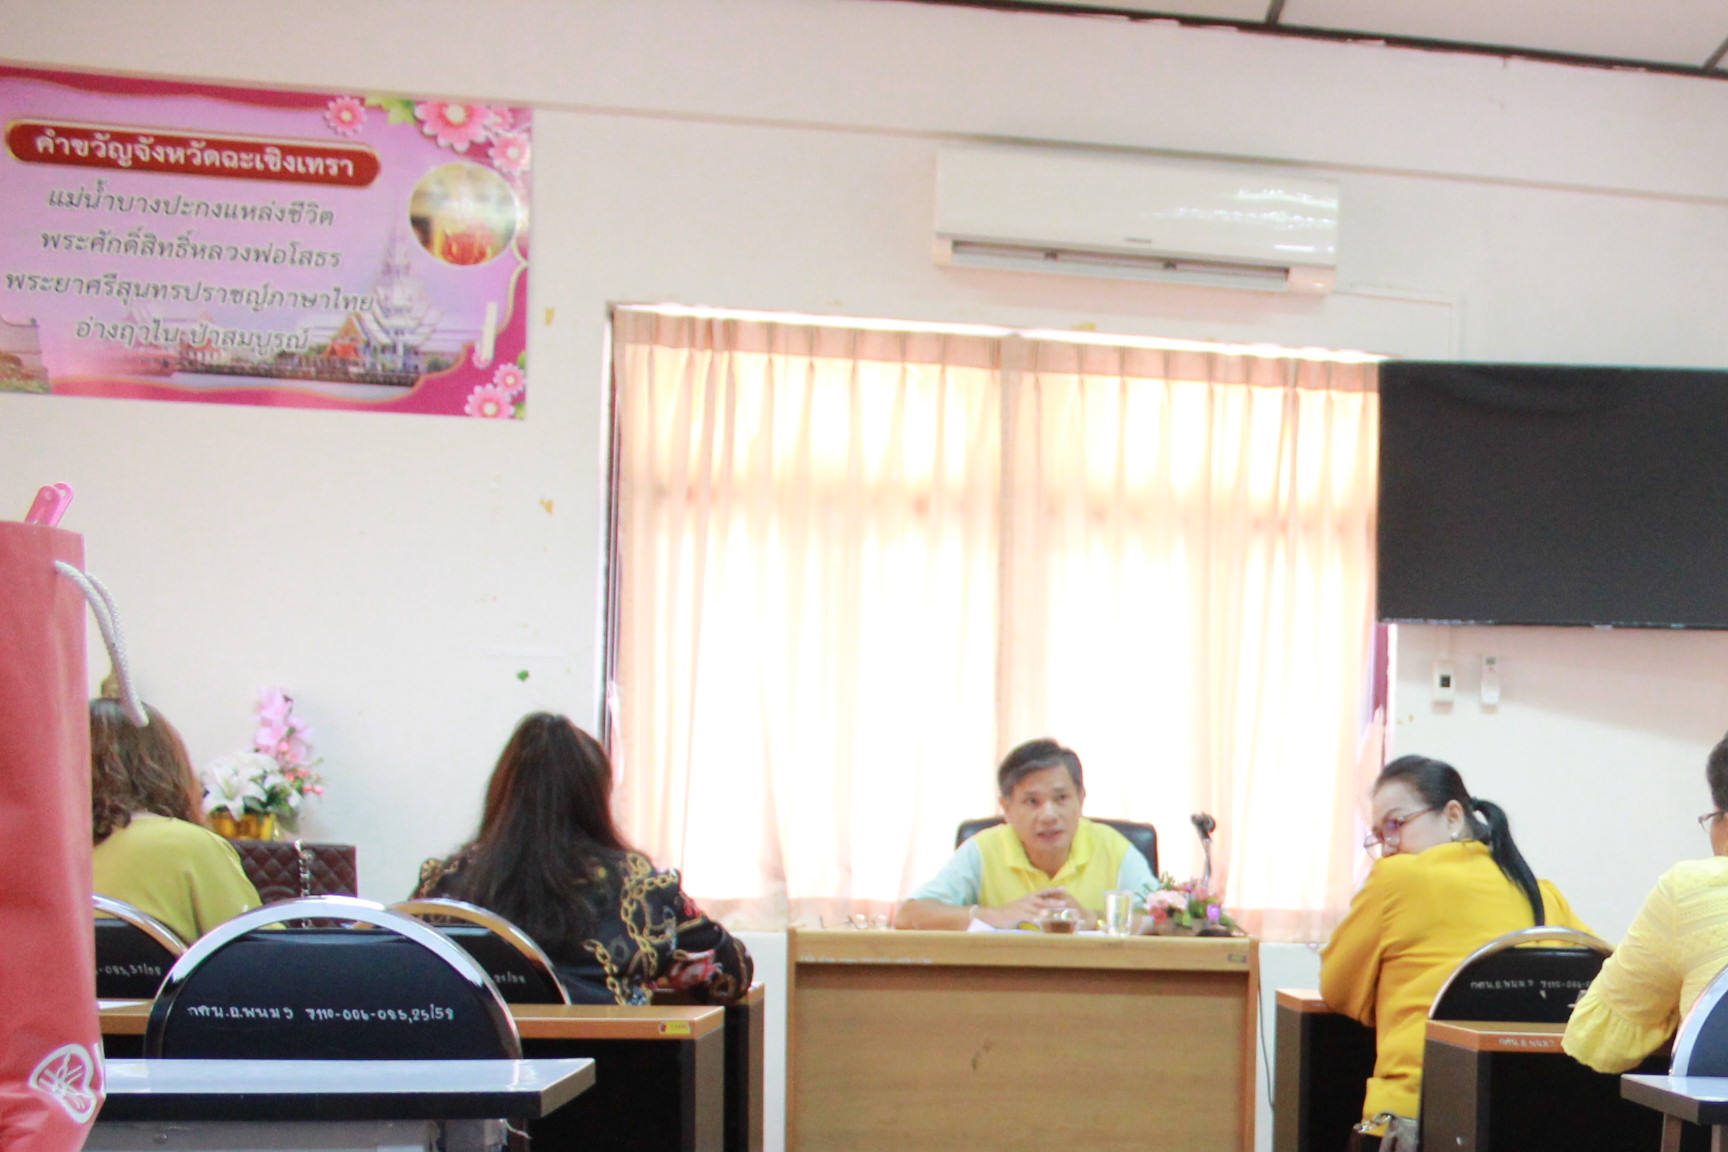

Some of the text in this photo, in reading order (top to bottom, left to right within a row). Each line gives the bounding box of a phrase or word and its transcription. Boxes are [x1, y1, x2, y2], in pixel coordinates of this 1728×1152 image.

[36, 129, 354, 177] คำขวัญจังหวัดฉะเชิงเทรา
[49, 179, 335, 226] แม่น้ำบางปะกงแหล่งชีวิต
[41, 228, 341, 268] พระศักดิ์สิทธิ์หลวงพ่อโสธร
[6, 272, 374, 312] พระยาศรีสุนทรปราชญ์ภาษาไทย
